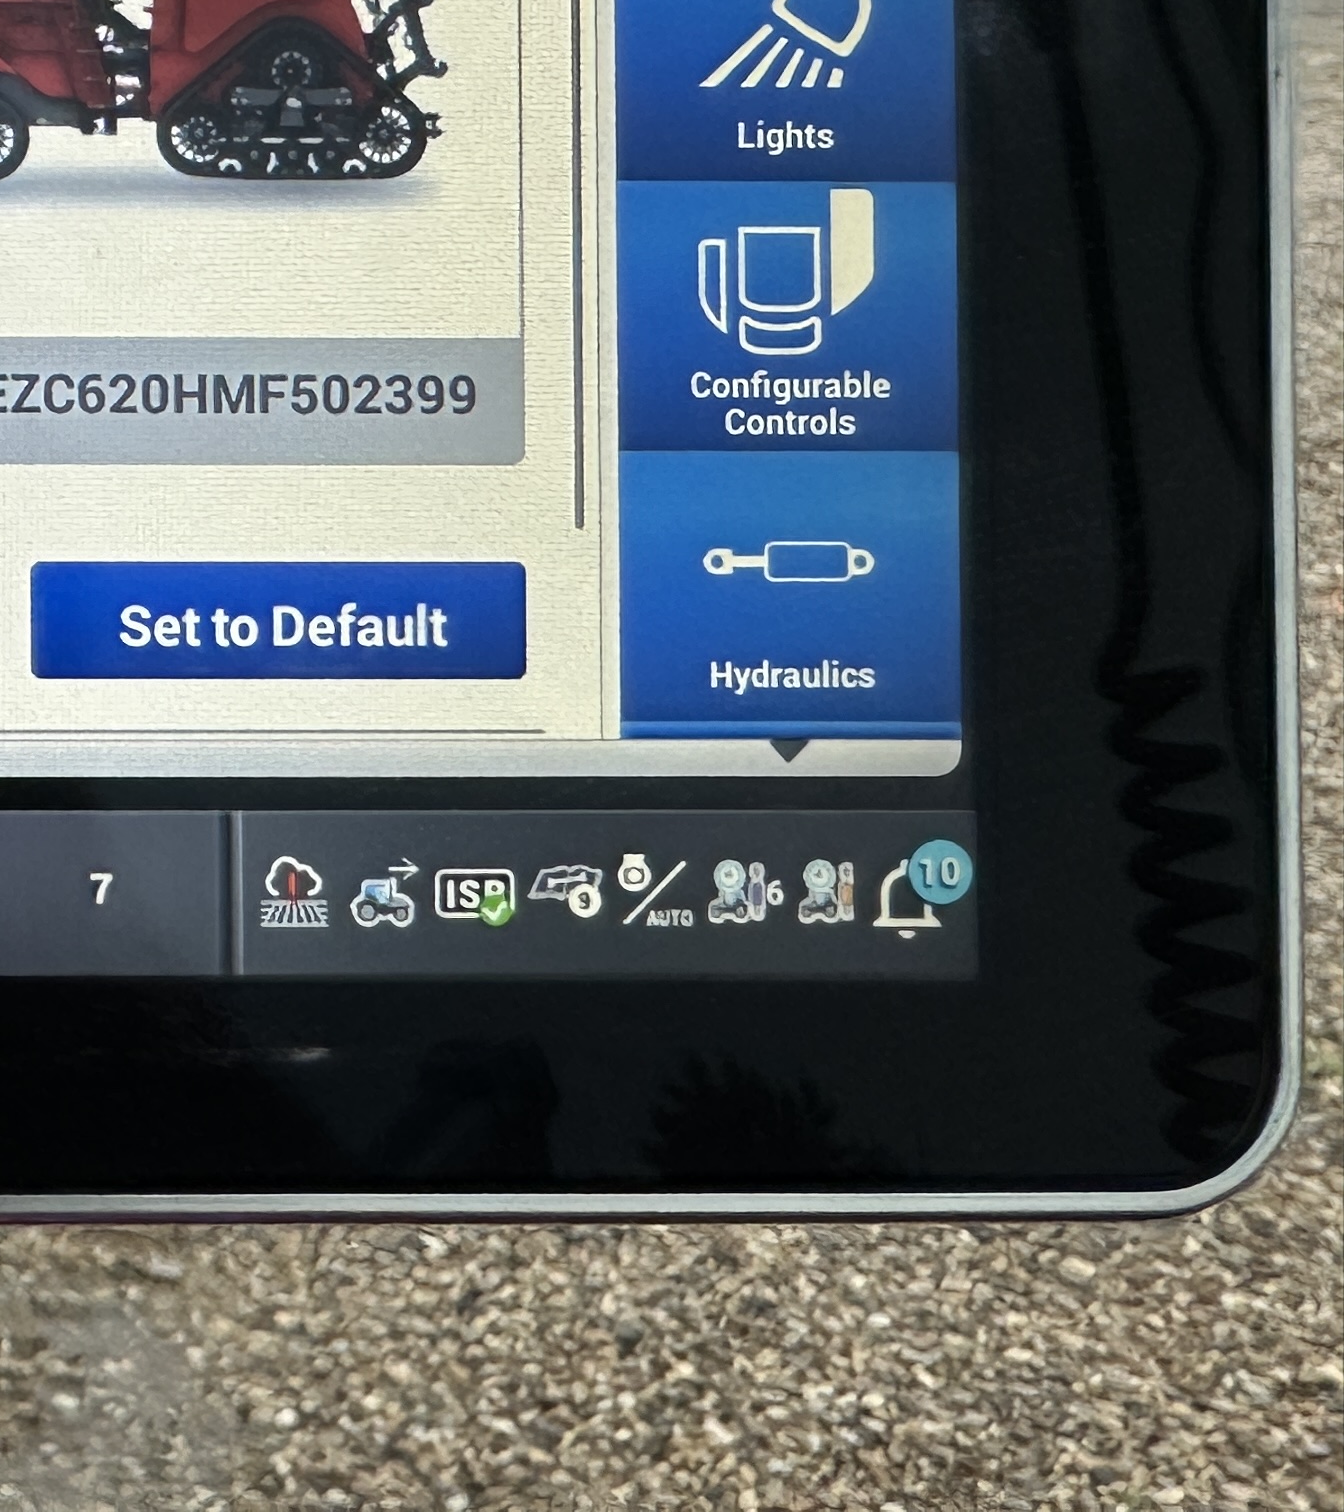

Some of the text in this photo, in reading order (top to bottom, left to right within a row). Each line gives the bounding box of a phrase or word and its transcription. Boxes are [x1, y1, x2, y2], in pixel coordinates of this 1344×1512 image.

[738, 120, 834, 155] Lights
[691, 370, 890, 405] Configurable
[725, 407, 856, 435] Controls
[120, 603, 448, 647] Set to Default
[711, 660, 875, 695] Hydraulics
[917, 855, 960, 886] 10
[90, 873, 113, 904] 7
[647, 909, 693, 926] AUTO
